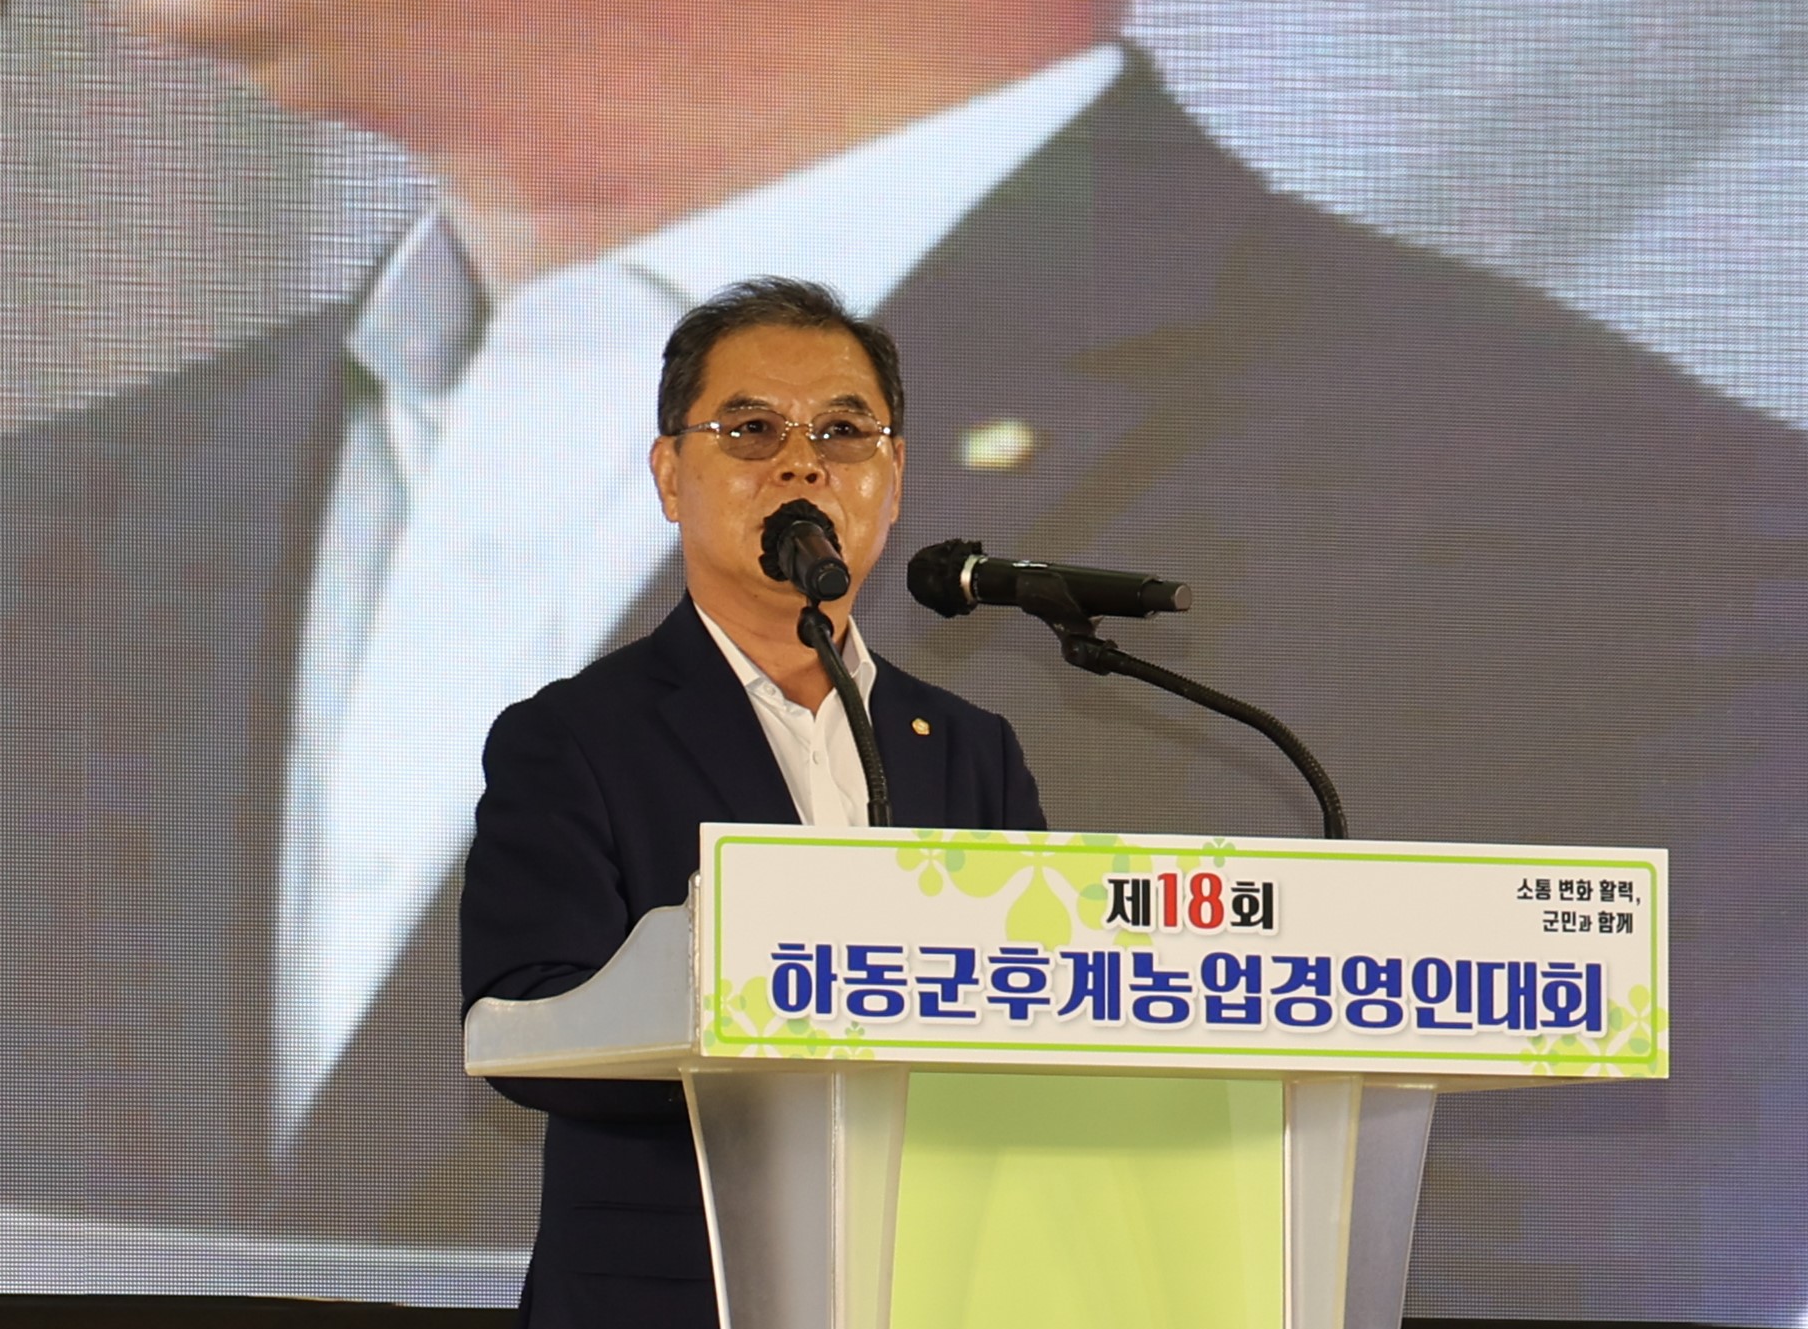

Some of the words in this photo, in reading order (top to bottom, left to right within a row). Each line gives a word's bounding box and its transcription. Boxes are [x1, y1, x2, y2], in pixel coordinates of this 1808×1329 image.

[1106, 872, 1274, 931] 제18회
[1516, 878, 1552, 901] 소통
[1558, 879, 1593, 902] 변화
[1599, 879, 1641, 906] 활력,
[1542, 910, 1593, 933] 군민과
[1597, 911, 1634, 934] 함께
[770, 942, 1603, 1032] 하동군후계농업경영인대회
